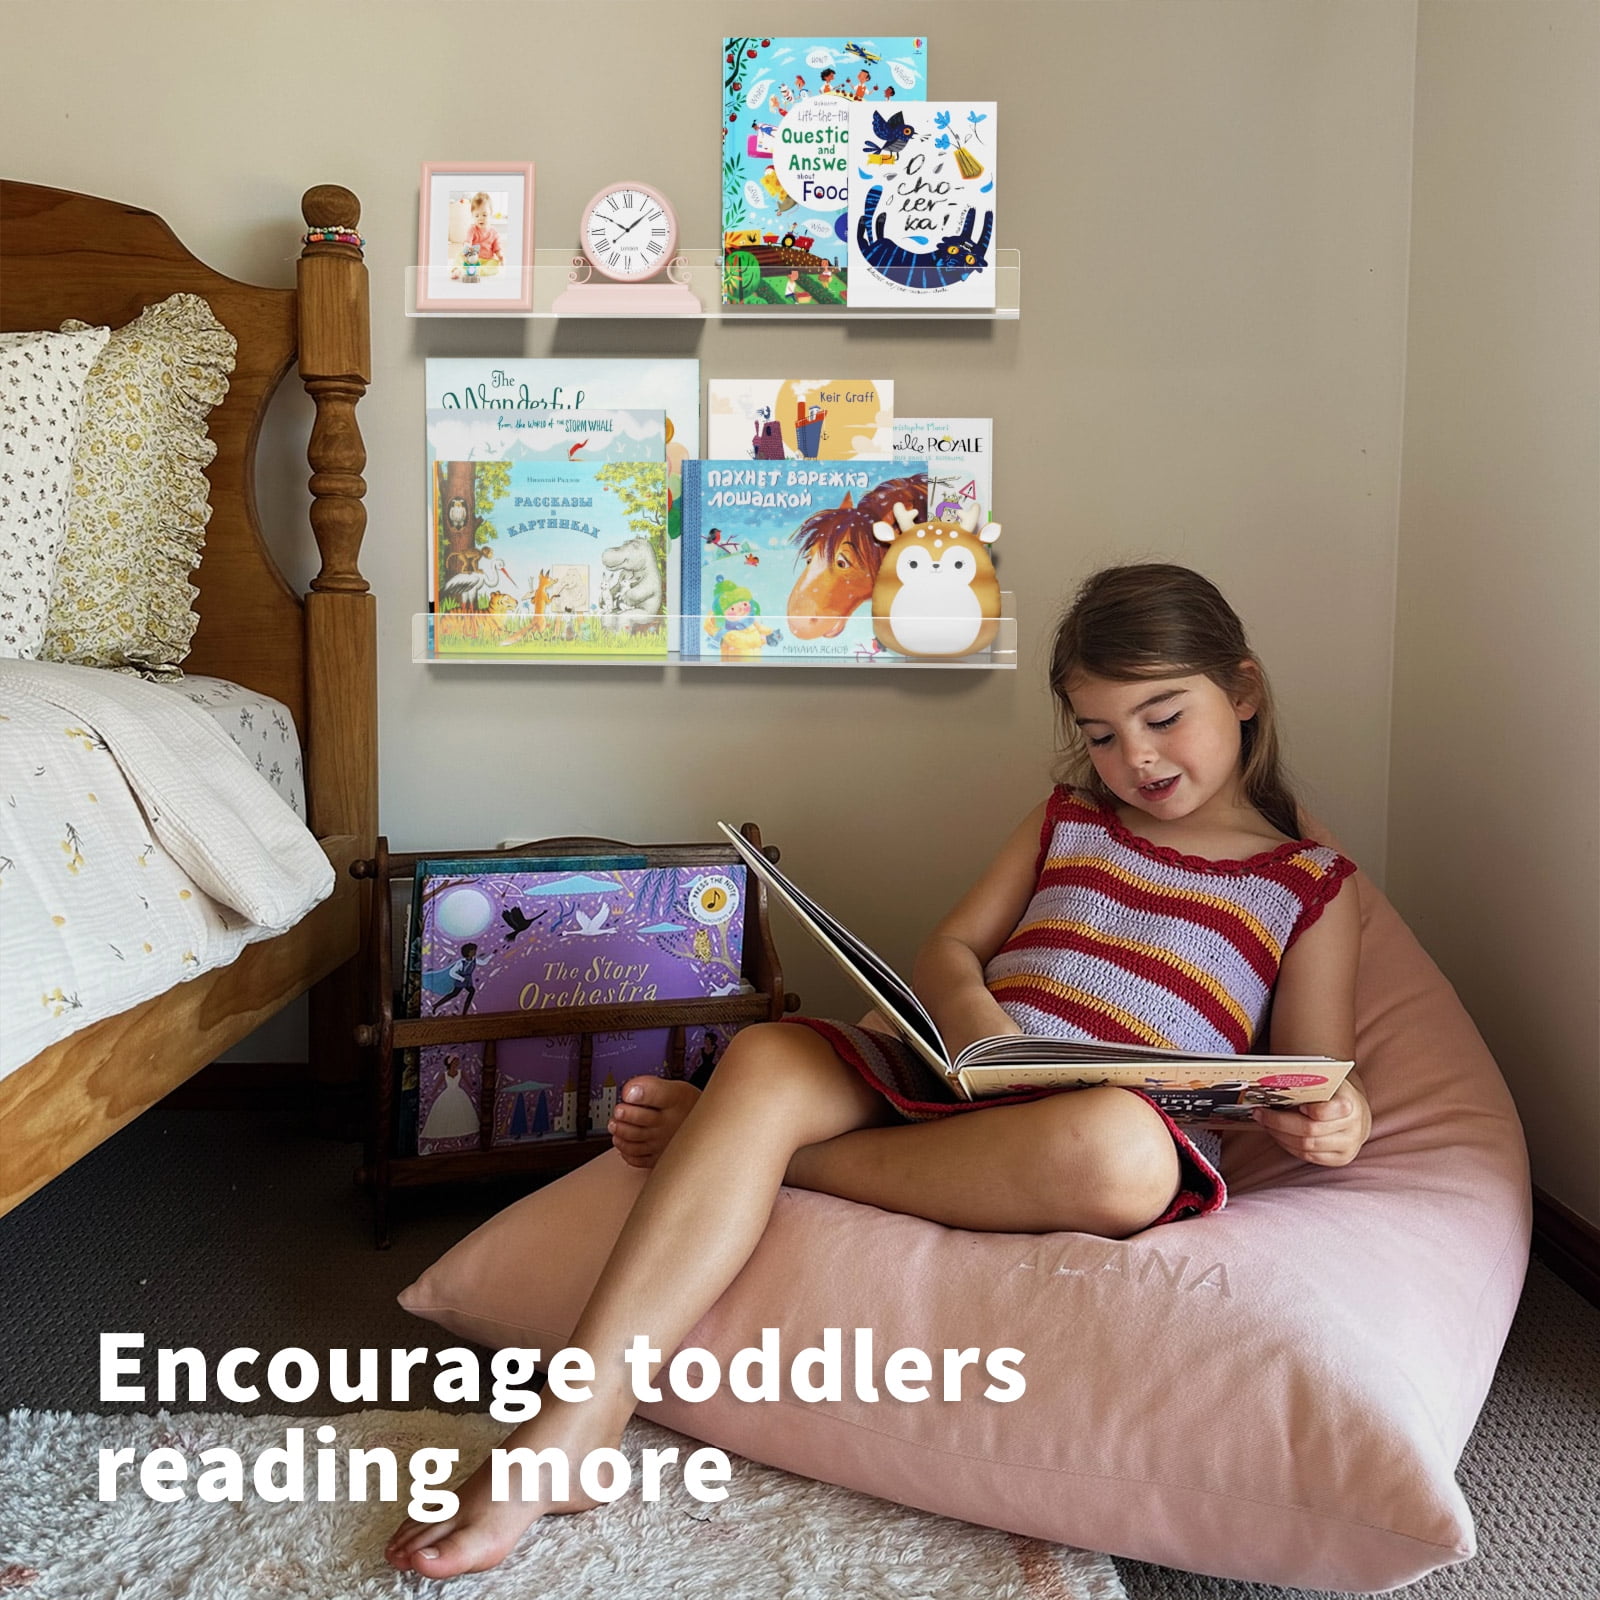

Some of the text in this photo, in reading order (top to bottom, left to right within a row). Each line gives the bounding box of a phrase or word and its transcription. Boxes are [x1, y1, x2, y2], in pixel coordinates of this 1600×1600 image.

[781, 126, 848, 143] Questio
[818, 144, 835, 155] and
[789, 154, 848, 171] Answe
[491, 369, 515, 389] The
[820, 392, 875, 403] Keir Graff
[497, 416, 514, 430] from
[515, 418, 526, 429] the
[548, 418, 554, 429] of
[565, 420, 587, 433] STORM
[588, 419, 614, 432] WHALE
[928, 437, 984, 453] ROYALE
[514, 496, 593, 508] РАССКАЗЫ
[507, 518, 600, 538] КАРТИНКАХ
[692, 880, 709, 898] PRESS
[724, 879, 736, 897] NOTE
[543, 955, 650, 983] The Story
[519, 980, 658, 1010] Orchestra
[545, 1035, 580, 1048] SWA
[1018, 1242, 1232, 1299] ALANA
